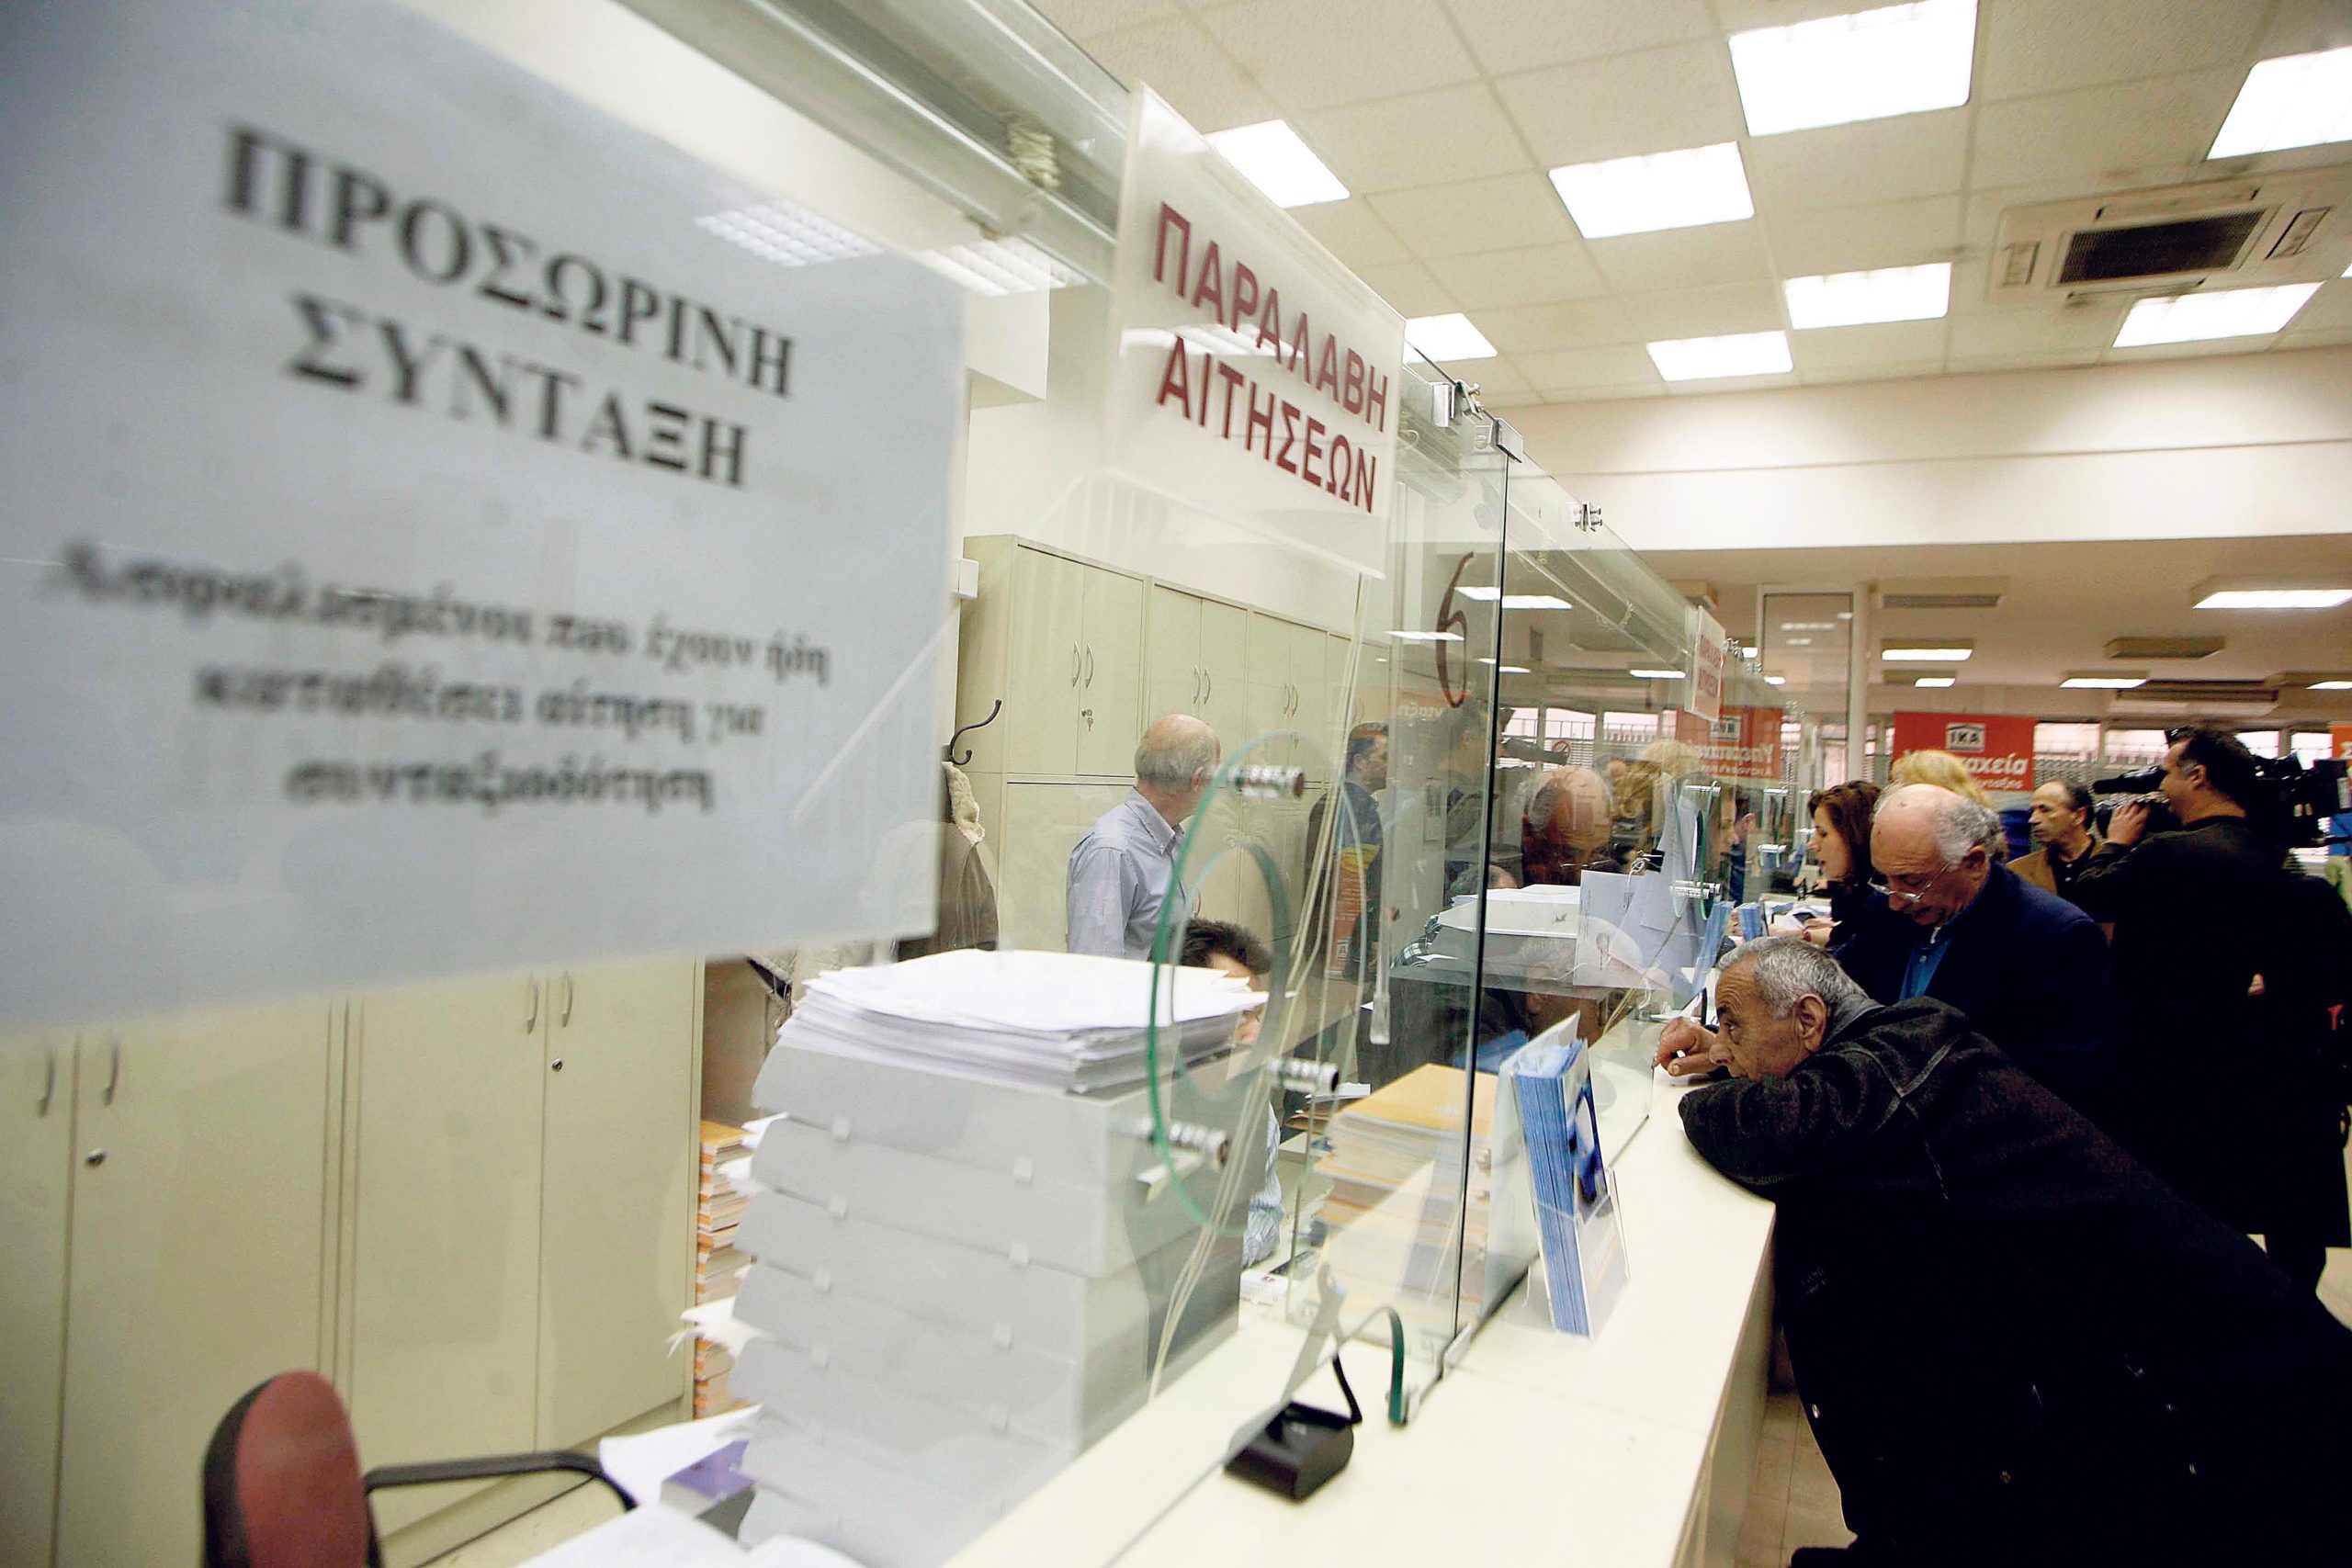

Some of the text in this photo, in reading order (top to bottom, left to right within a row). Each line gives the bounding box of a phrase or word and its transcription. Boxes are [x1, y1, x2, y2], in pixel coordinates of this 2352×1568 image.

[220, 122, 797, 399] ΠΡΟΣΩΡΙΝΗ
[1154, 200, 1388, 434] ΠΑΡΑΛΑΒΗ
[282, 292, 752, 489] ΣΥΝΤΑΞΗ
[1156, 335, 1376, 514] ΑΙΤΗΣΕΩΝ
[537, 677, 695, 743] αίτηση
[706, 701, 765, 744] για
[548, 612, 632, 655] που
[646, 610, 753, 672] έχουν
[765, 629, 830, 687] ήδη
[1950, 731, 1980, 743] ΙΚΑ
